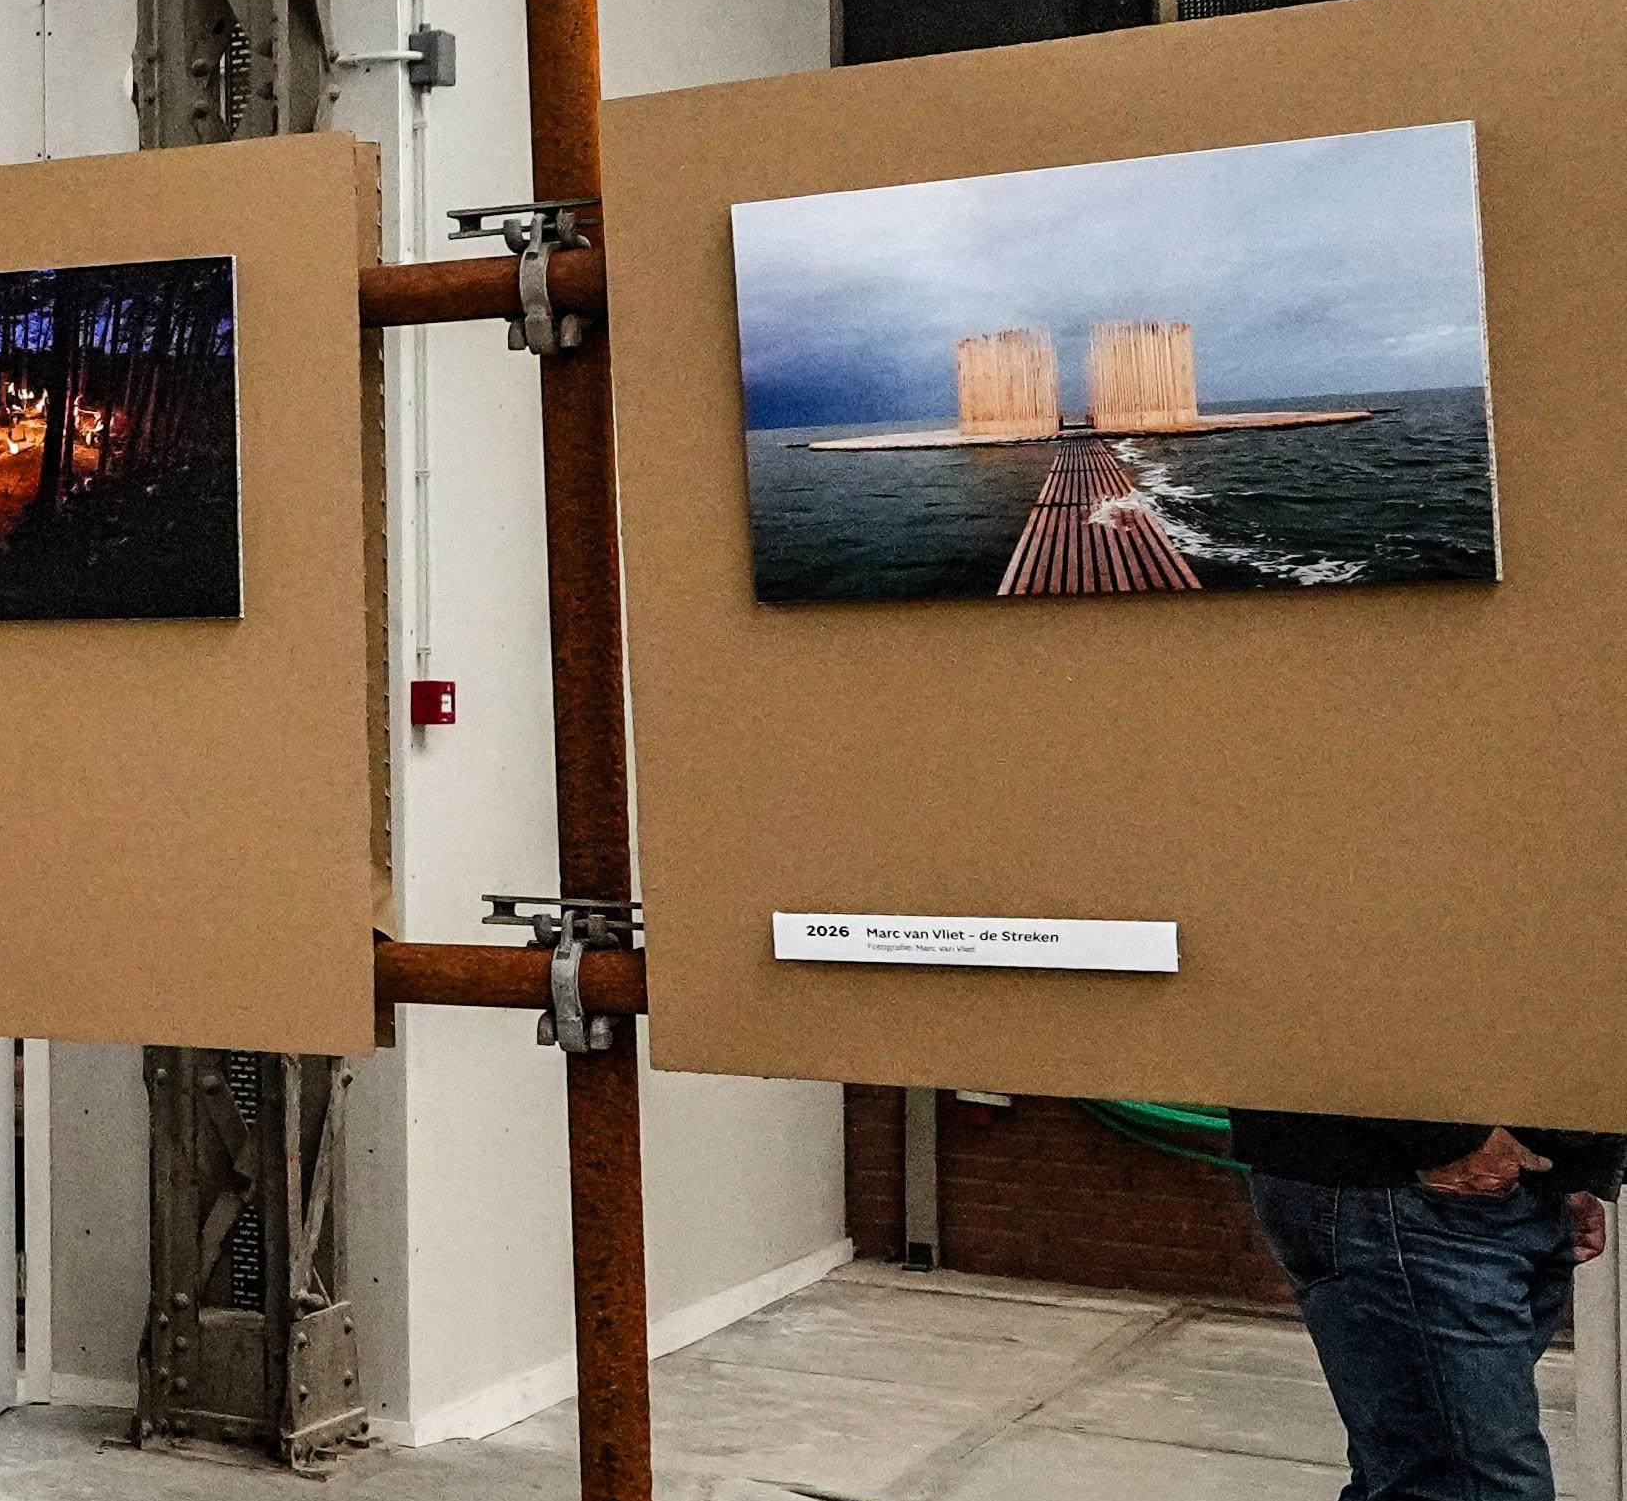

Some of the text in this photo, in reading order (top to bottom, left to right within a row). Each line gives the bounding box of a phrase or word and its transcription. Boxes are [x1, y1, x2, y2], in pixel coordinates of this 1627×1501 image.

[806, 925, 850, 937] 2026
[866, 928, 900, 940] Marc
[904, 930, 929, 940] van
[932, 929, 965, 941] Vliet
[979, 930, 997, 941] de
[1001, 931, 1059, 943] Streken
